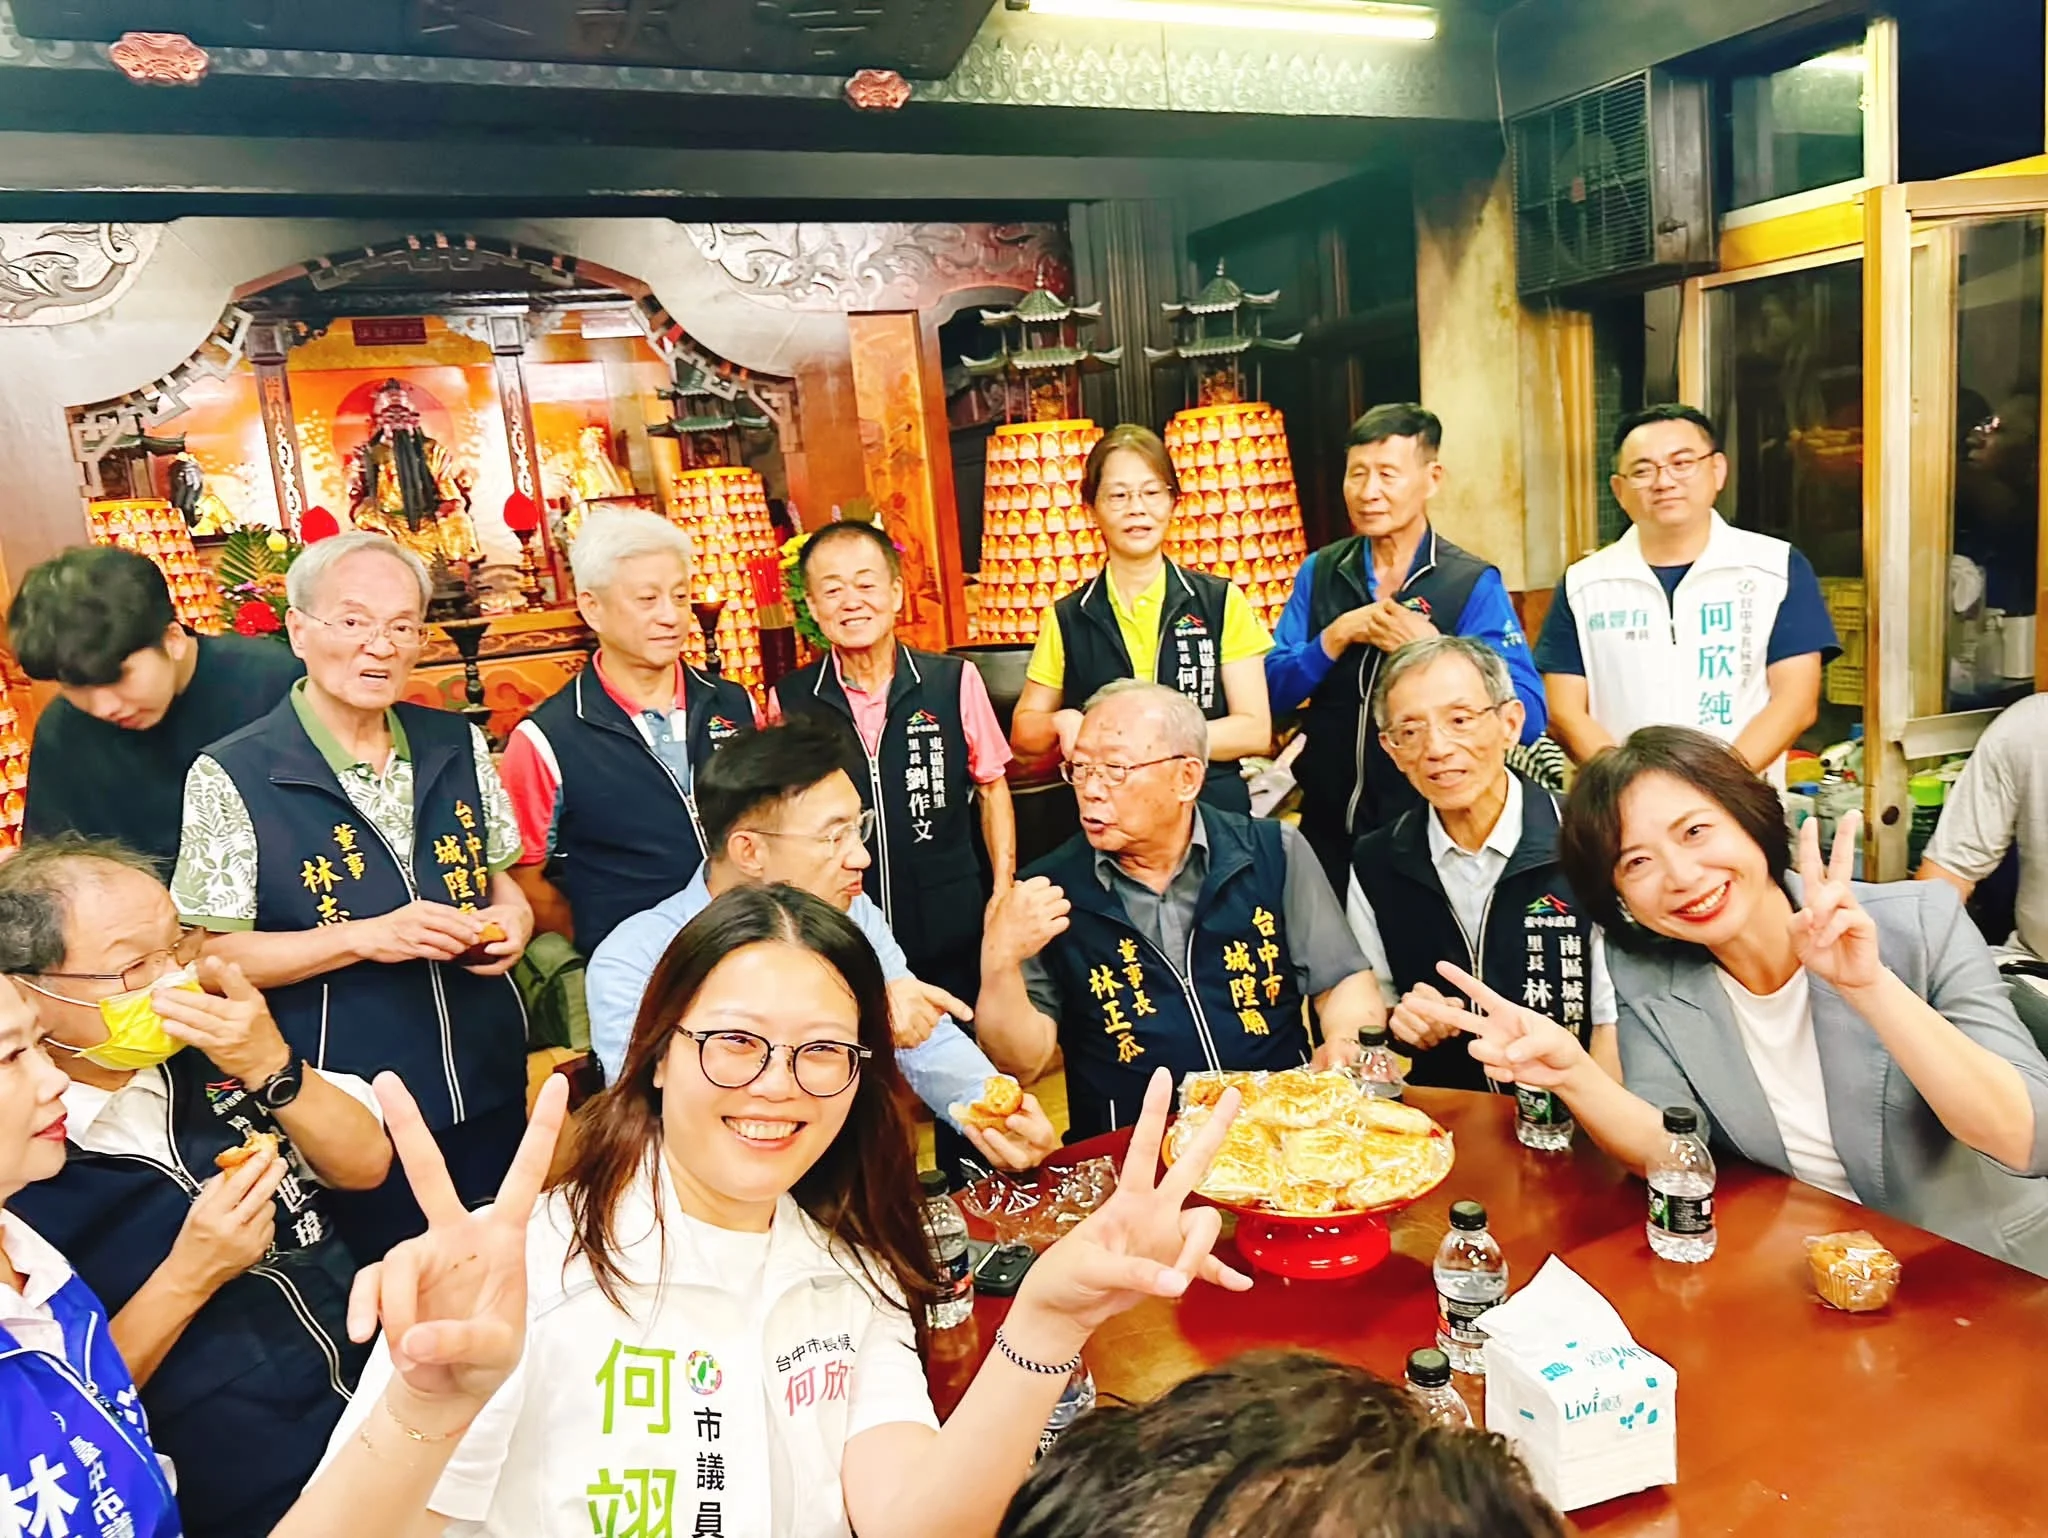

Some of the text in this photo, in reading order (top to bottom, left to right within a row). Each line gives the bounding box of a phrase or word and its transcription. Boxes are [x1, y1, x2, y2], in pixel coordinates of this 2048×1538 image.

[1698, 600, 1735, 726] 何欣純
[905, 766, 934, 843] 劉作文
[333, 823, 365, 880] 董事
[454, 799, 488, 897] 台中市
[1117, 937, 1158, 1016] 董事長
[1223, 940, 1270, 1035] 城隍廟
[1252, 906, 1294, 1006] 台中市
[775, 1333, 857, 1372] 台中市長候
[784, 1360, 854, 1416] 何欣
[1564, 1388, 1600, 1421] Livi
[692, 1406, 726, 1538] 市議員
